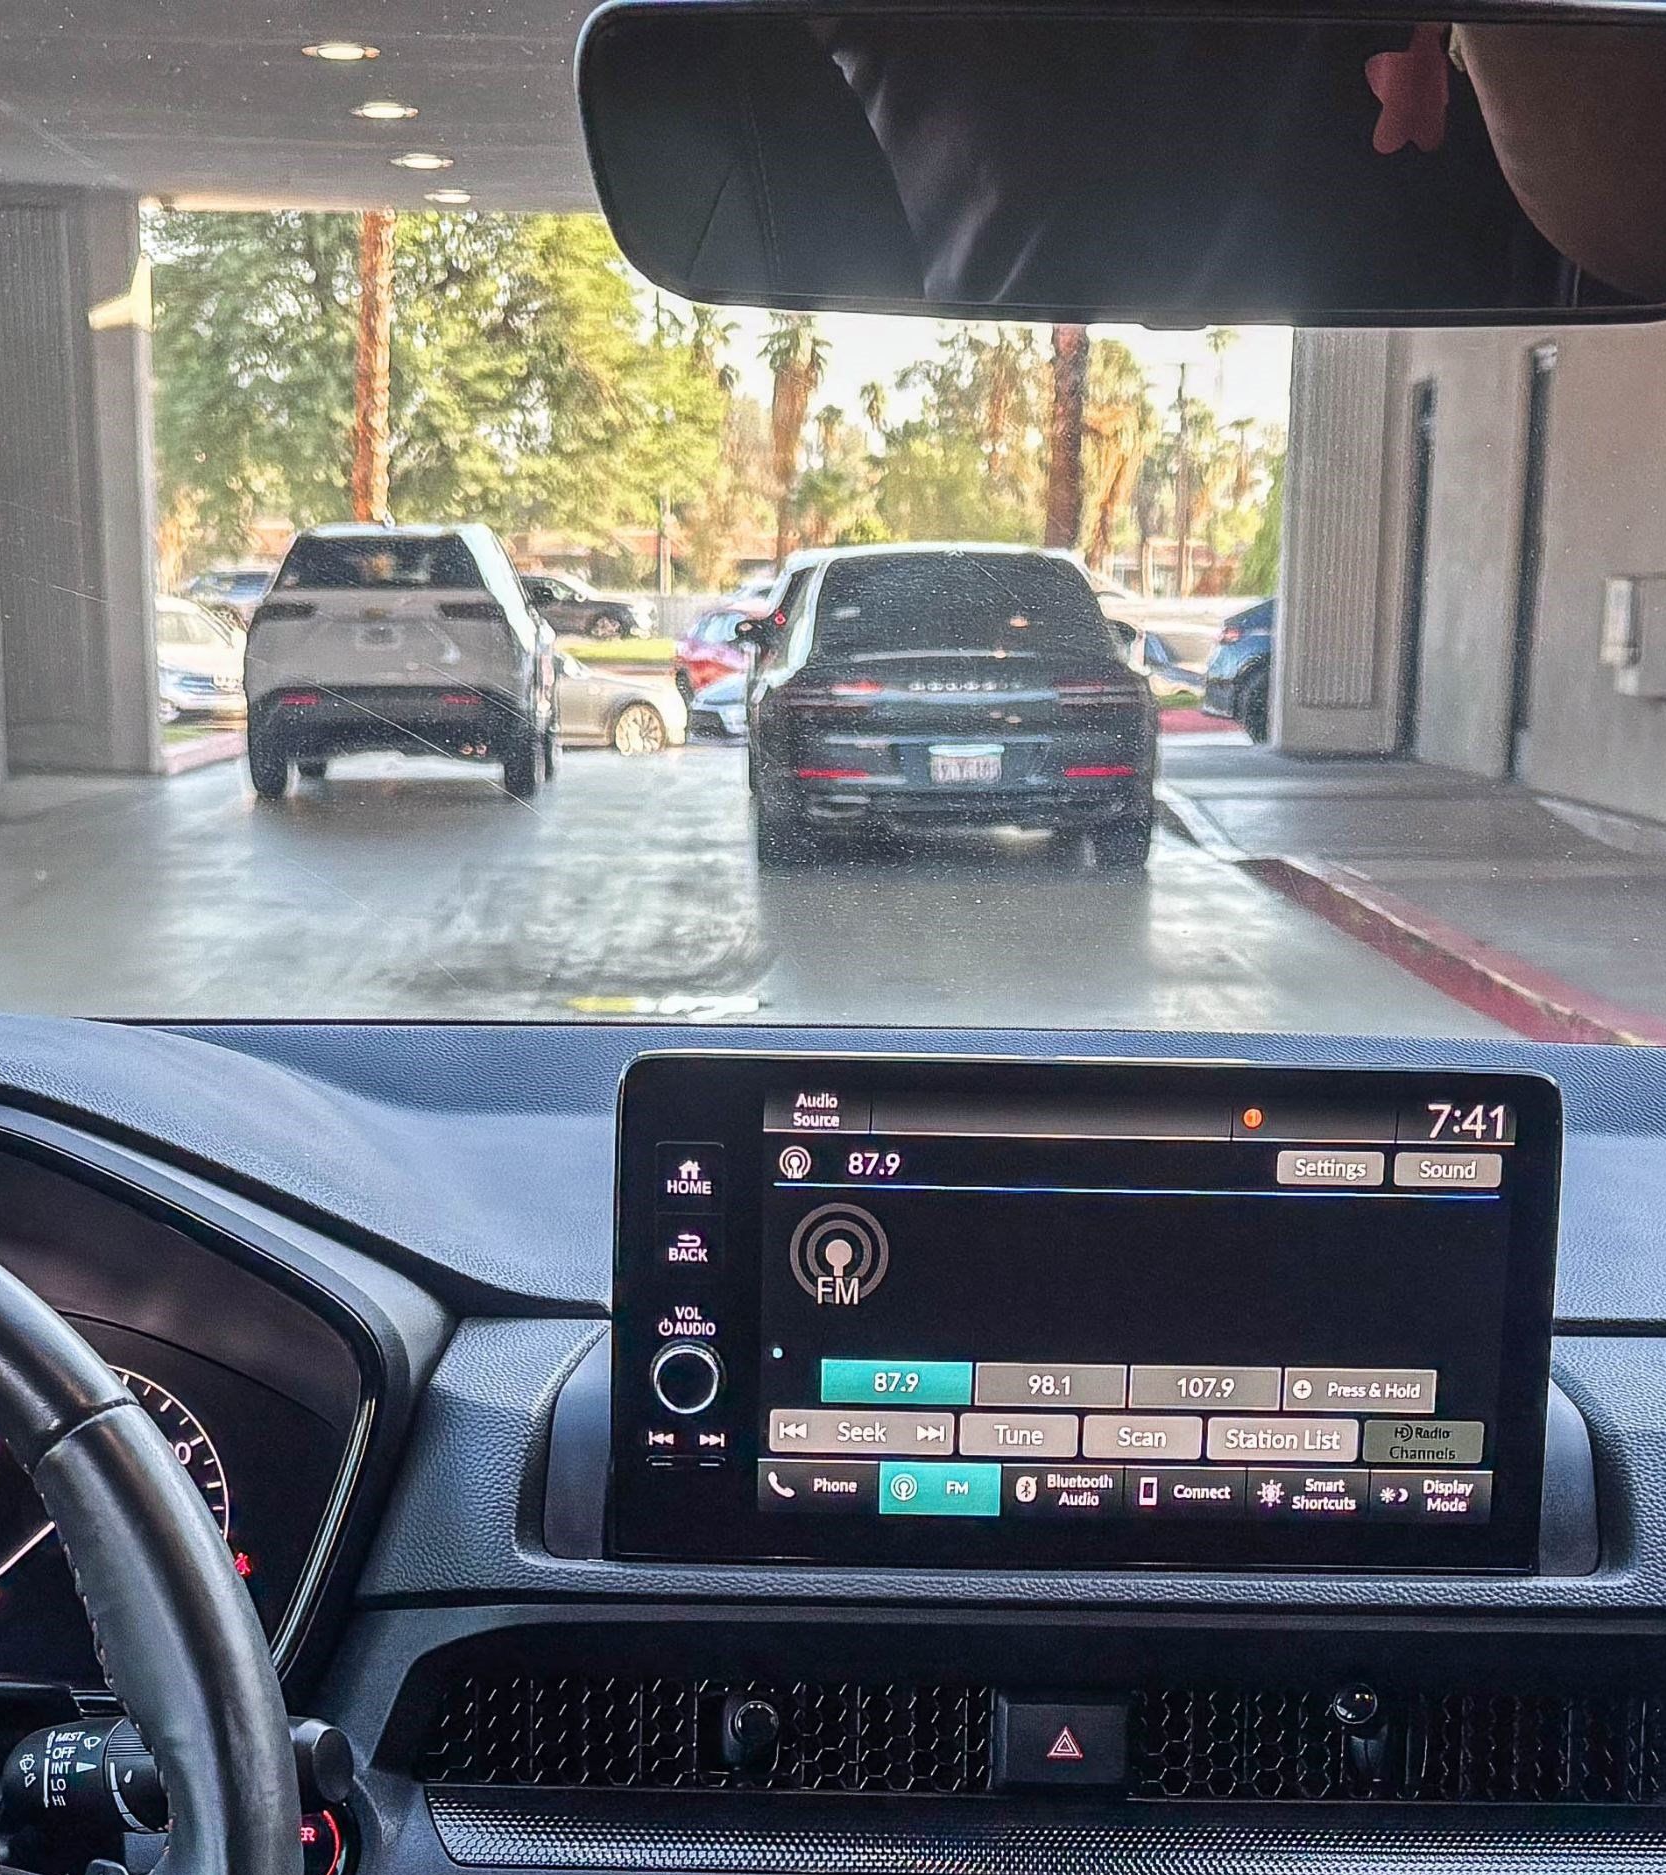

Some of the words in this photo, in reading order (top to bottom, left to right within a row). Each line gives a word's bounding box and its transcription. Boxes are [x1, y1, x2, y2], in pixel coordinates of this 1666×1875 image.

[795, 1093, 839, 1110] Audio
[793, 1111, 840, 1129] Source
[1427, 1103, 1507, 1140] 7:41
[847, 1152, 901, 1177] 87.9
[1295, 1158, 1368, 1181] Settings
[1419, 1160, 1477, 1180] Sound
[666, 1180, 712, 1196] HOME
[668, 1247, 708, 1263] BACK
[816, 1276, 860, 1305] FM
[675, 1306, 702, 1321] VOL
[674, 1321, 717, 1337] AUDIO
[874, 1372, 920, 1394] 87.9
[1027, 1374, 1072, 1397] 98.1
[1175, 1376, 1236, 1399] 107.9
[1327, 1382, 1367, 1399] Press
[1368, 1383, 1382, 1399] &
[1385, 1383, 1421, 1400] Hold
[837, 1421, 887, 1444] Seek
[993, 1424, 1044, 1447] Tune
[1117, 1427, 1168, 1449] Scan
[1225, 1429, 1298, 1451] Station
[1303, 1431, 1341, 1452] List
[1415, 1427, 1451, 1439] Radio
[1389, 1446, 1456, 1460] Channels
[813, 1478, 857, 1495] Phone
[946, 1480, 969, 1496] FM
[1046, 1474, 1114, 1489] Bluetooth
[1305, 1478, 1345, 1494] Smart
[1423, 1479, 1474, 1497] Display
[1058, 1491, 1100, 1507] Audio
[1173, 1484, 1231, 1500] Connect
[1291, 1494, 1356, 1512] Shortcuts
[1427, 1498, 1467, 1512] Mode
[55, 1731, 86, 1743] MIST
[52, 1746, 76, 1759] OFF
[51, 1761, 71, 1774] INT
[50, 1778, 66, 1792] LO
[52, 1795, 66, 1806] HI
